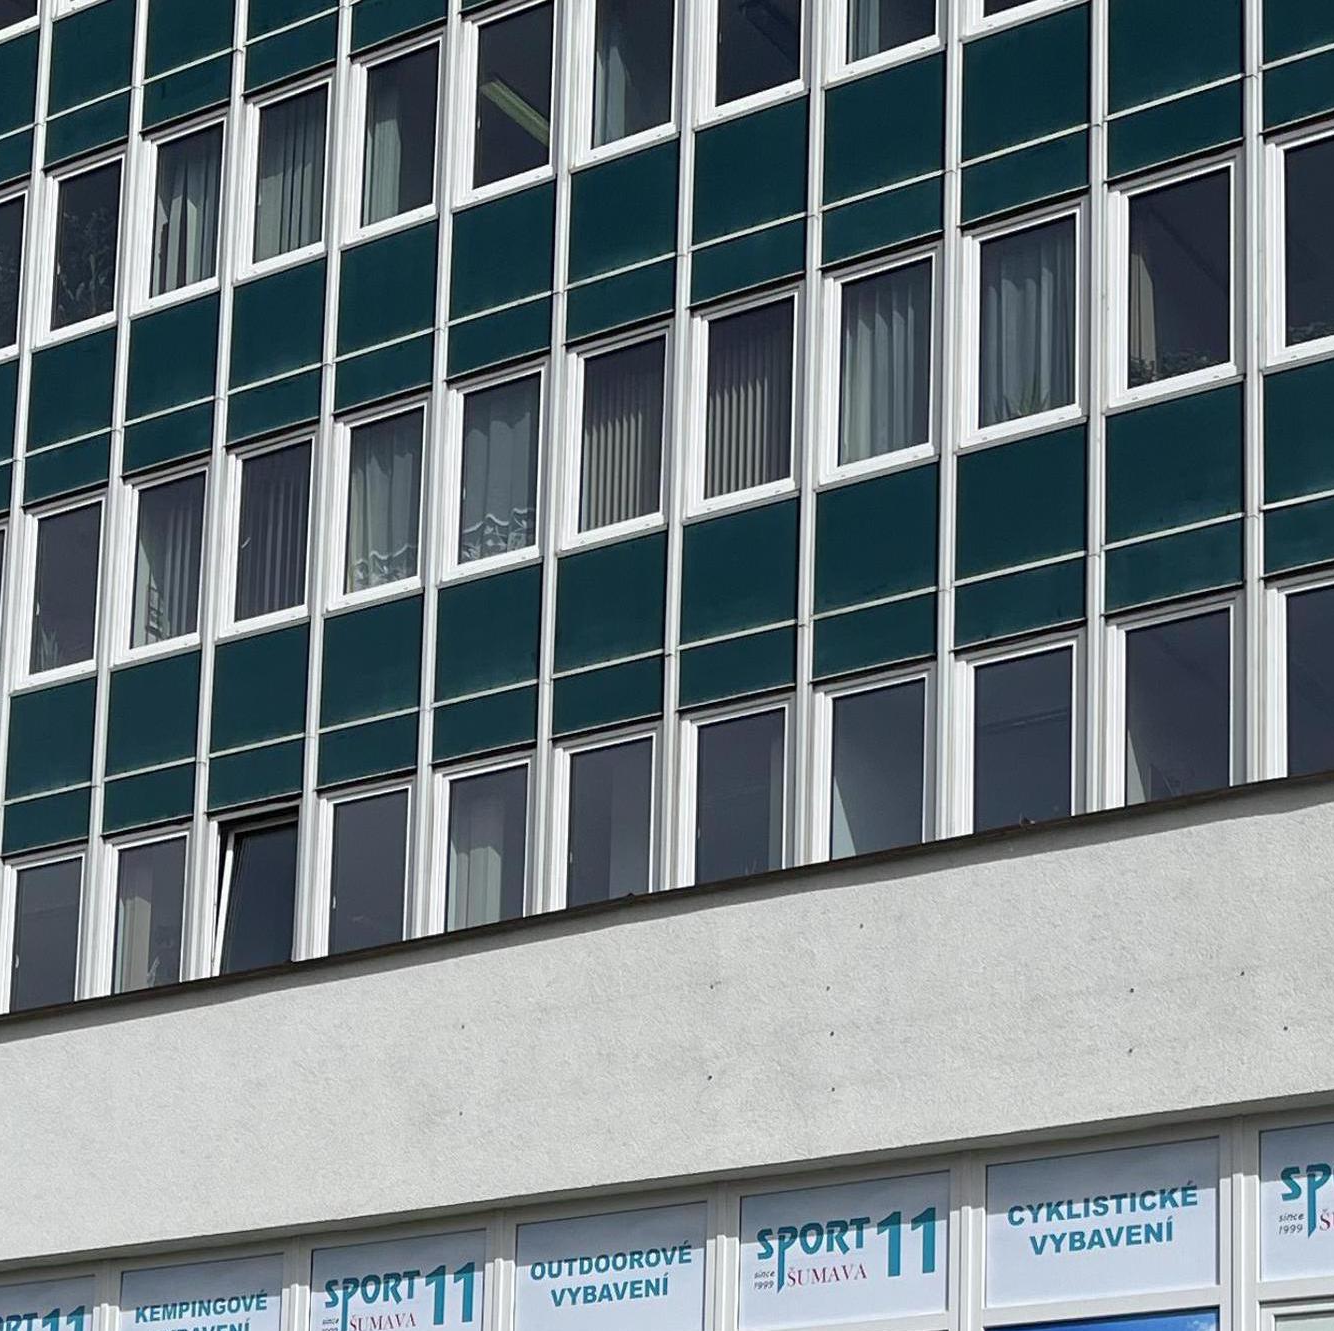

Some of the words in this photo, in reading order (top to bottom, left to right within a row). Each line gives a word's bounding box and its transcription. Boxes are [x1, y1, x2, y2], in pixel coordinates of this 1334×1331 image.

[1007, 1180, 1199, 1227] CYKLISTICKÉ
[1278, 1212, 1305, 1222] since
[1030, 1215, 1174, 1256] VYBAVENÍ
[1278, 1224, 1304, 1235] 1999
[530, 1240, 693, 1281] OUTDOOROVÉ
[757, 1216, 872, 1293] SPORT
[876, 1207, 937, 1278] 11
[424, 1261, 476, 1326] 11
[551, 1272, 670, 1307] VYBAVENÍ
[786, 1264, 868, 1288] ŠUMAVA
[135, 1289, 268, 1324] KEMPINGOVÉ
